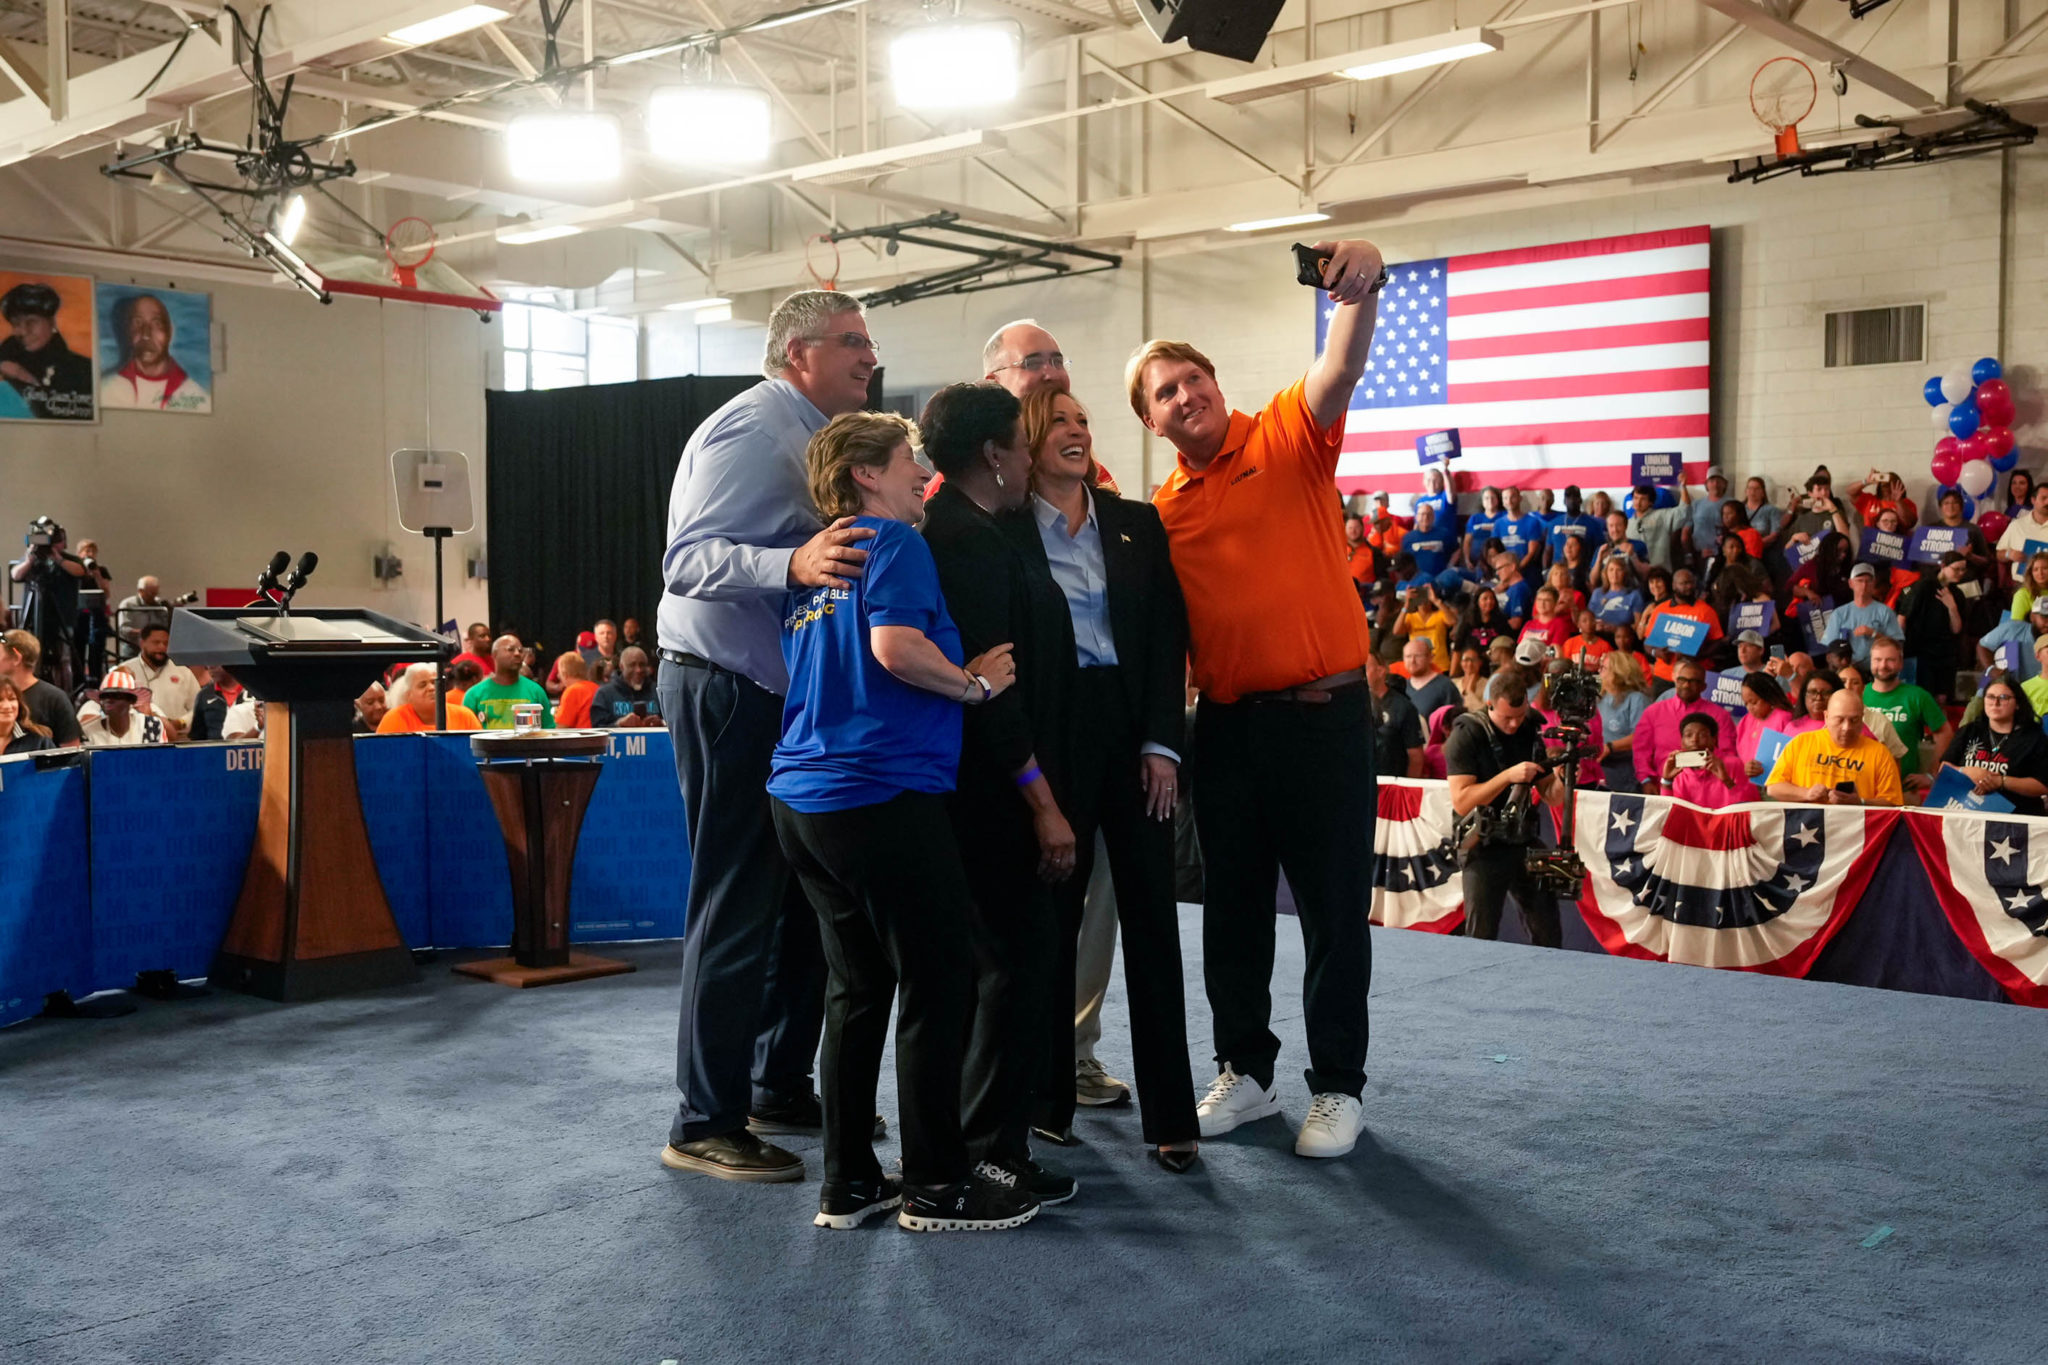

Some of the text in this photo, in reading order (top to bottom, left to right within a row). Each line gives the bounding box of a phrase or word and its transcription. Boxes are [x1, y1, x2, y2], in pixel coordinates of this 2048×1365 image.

[1424, 440, 1454, 457] STRONG
[1644, 454, 1670, 465] UNION
[1640, 465, 1674, 477] STRONG
[1875, 532, 1904, 548] UNION
[1926, 529, 1954, 541] UNION
[1869, 542, 1905, 561] STRONG
[1919, 540, 1955, 552] STRONG
[1740, 604, 1763, 617] UNION
[1664, 620, 1696, 638] LABOR
[1736, 615, 1763, 629] STRONG
[1711, 688, 1747, 706] STRON
[626, 736, 646, 755] MI
[1817, 753, 1864, 772] UFCW
[975, 1160, 1018, 1188] HOKA
